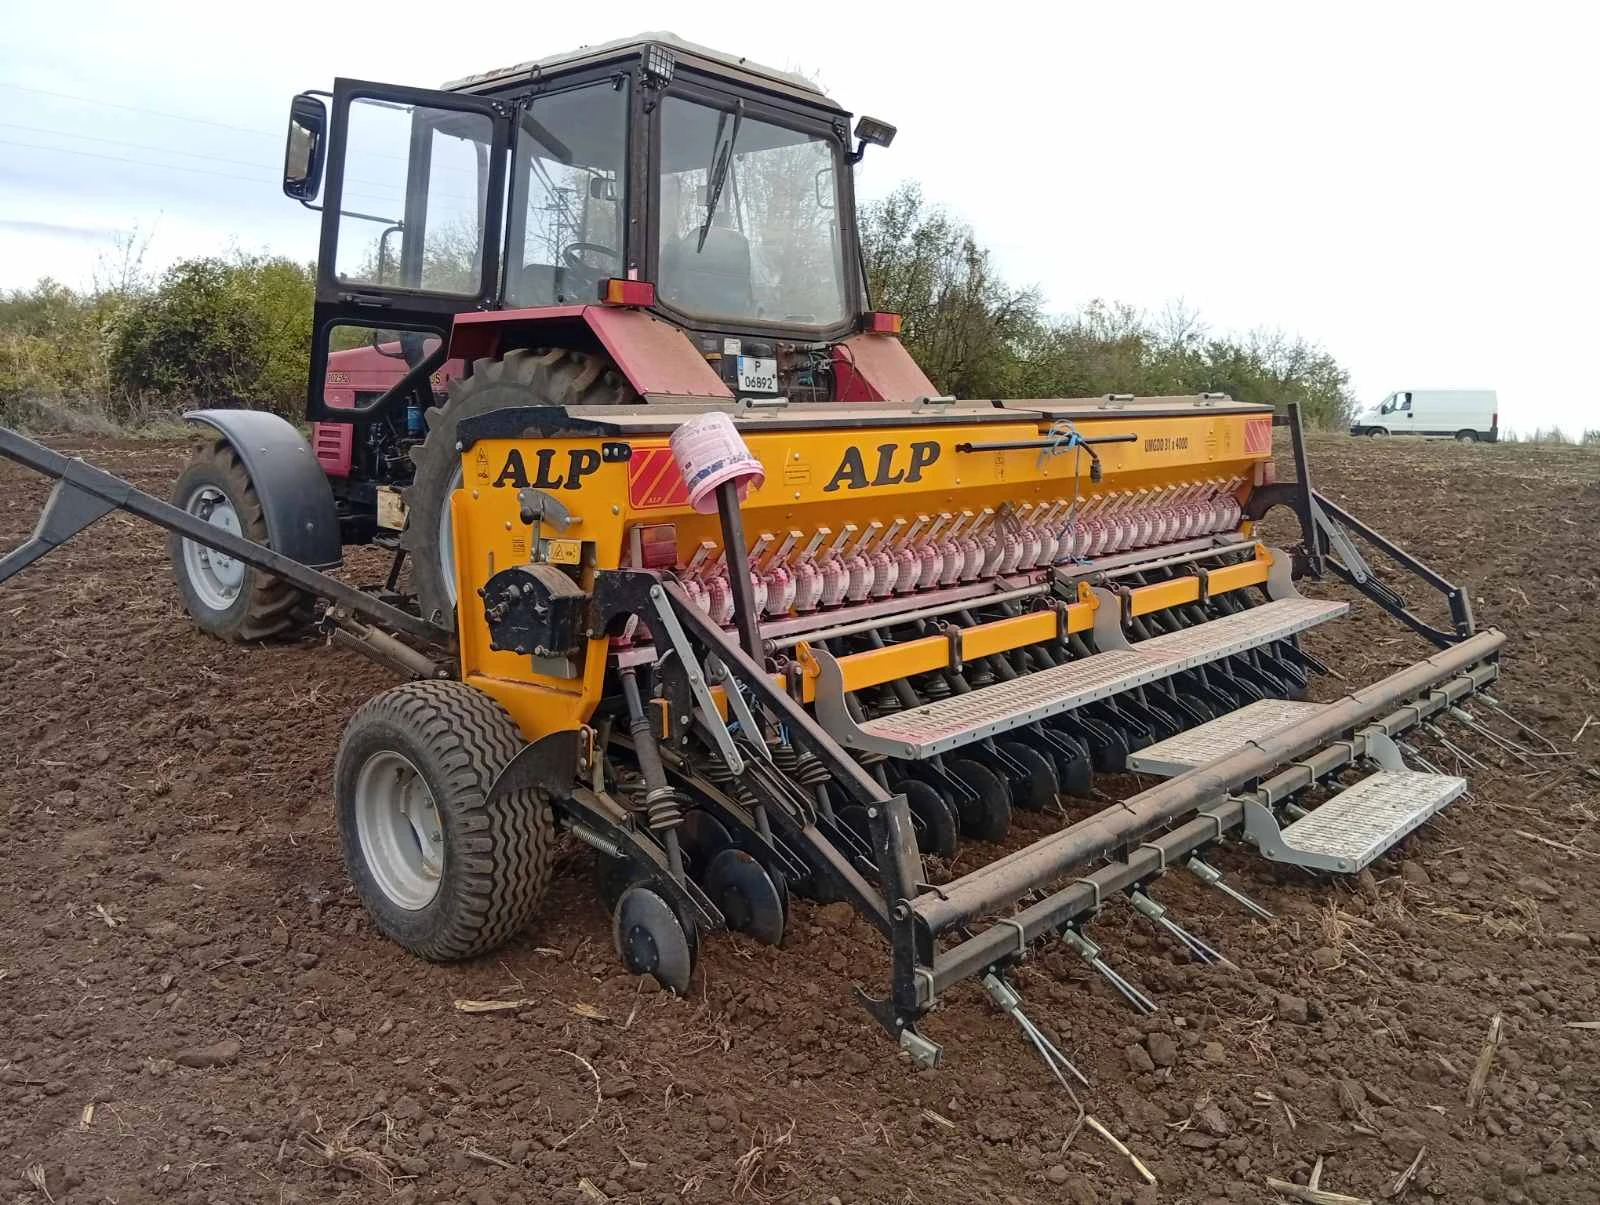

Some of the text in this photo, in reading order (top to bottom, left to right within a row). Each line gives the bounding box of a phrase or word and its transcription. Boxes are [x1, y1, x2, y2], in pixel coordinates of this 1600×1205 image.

[755, 360, 761, 373] P
[745, 374, 773, 390] 06892
[1176, 437, 1188, 450] 4000
[491, 448, 602, 490] ALP
[823, 440, 941, 492] ALP
